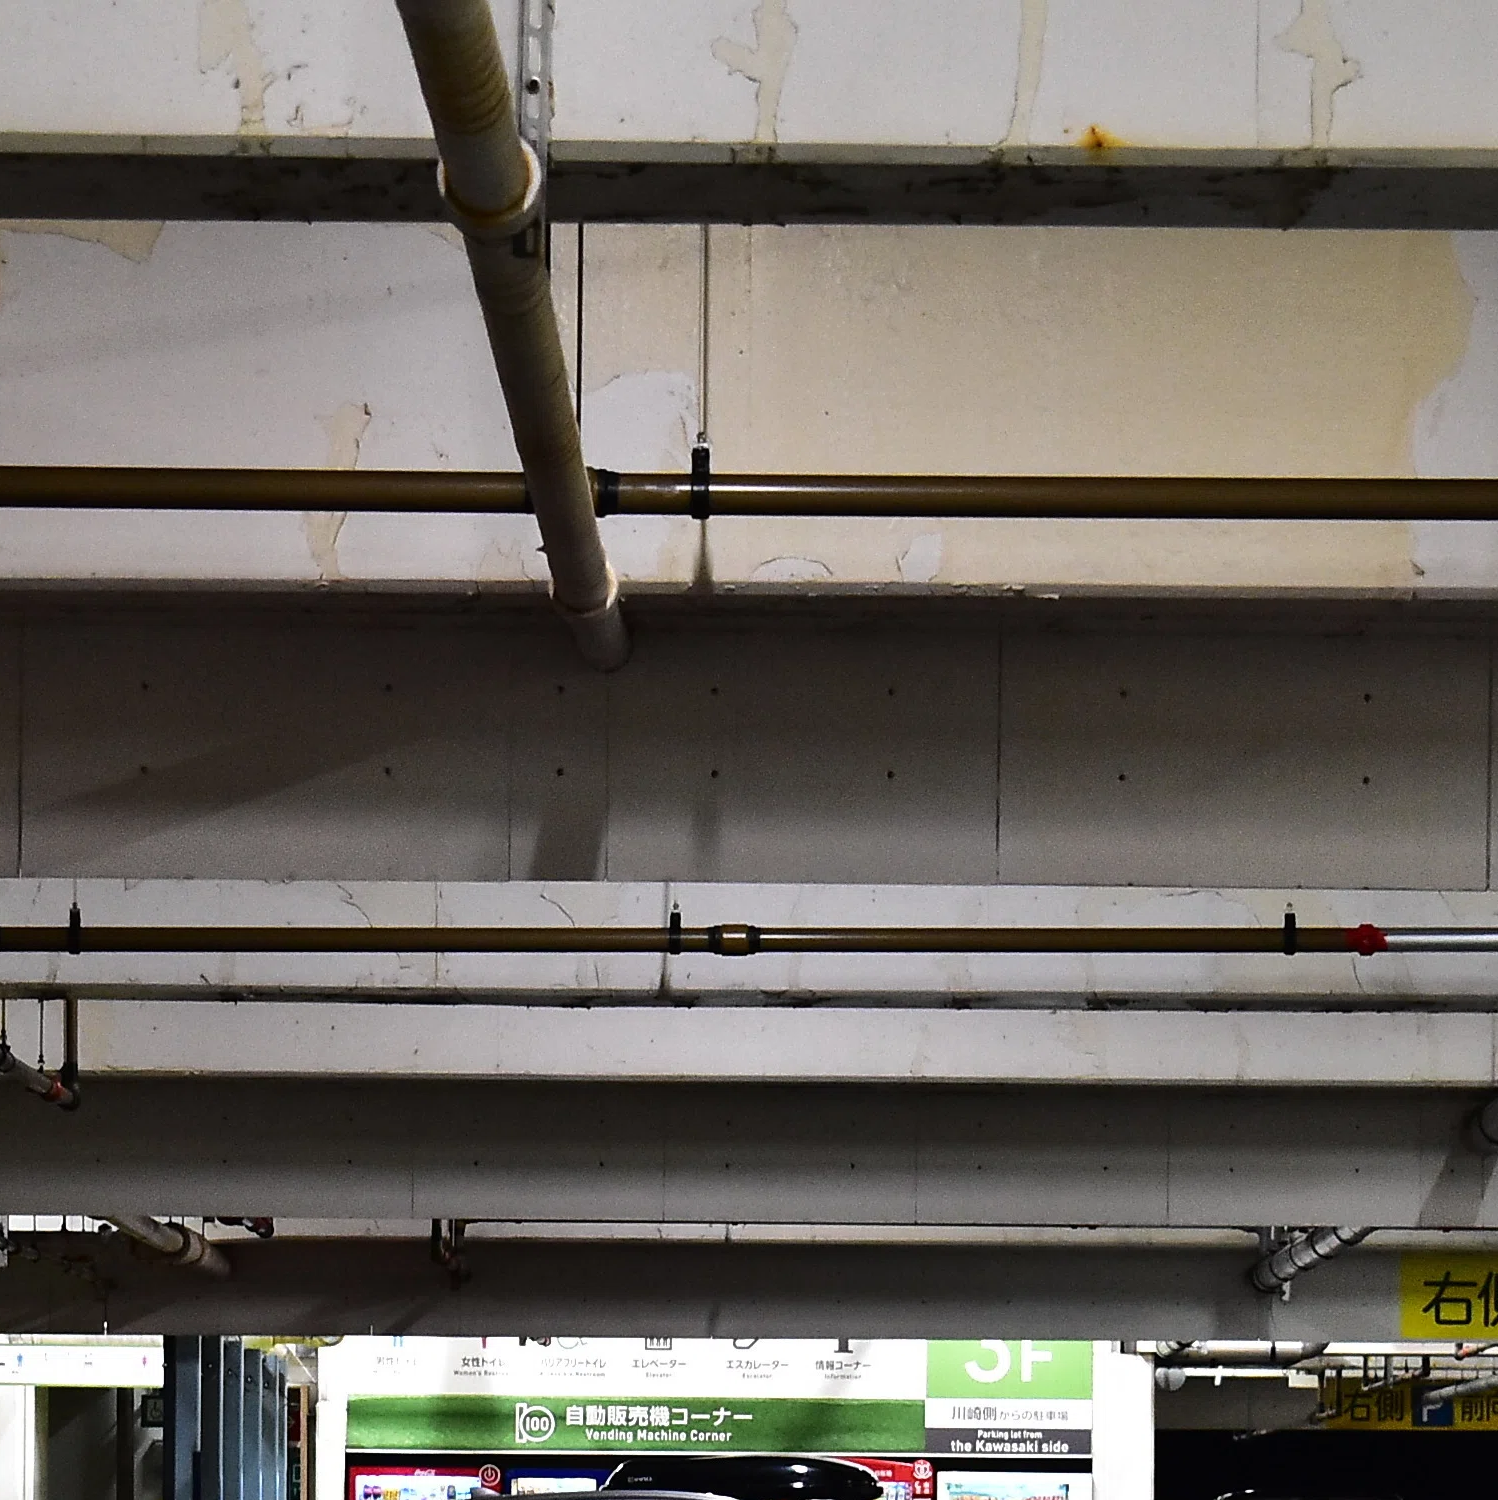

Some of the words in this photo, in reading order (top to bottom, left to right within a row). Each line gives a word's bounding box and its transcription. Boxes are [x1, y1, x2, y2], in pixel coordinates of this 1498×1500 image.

[630, 1359, 687, 1369] エレベーター
[725, 1359, 789, 1370] エスカレーター
[814, 1359, 872, 1371] 情報コーナー
[565, 1404, 754, 1427] 自動販売機コーナー
[585, 1428, 634, 1443] Vending
[637, 1428, 688, 1442] Machine
[690, 1429, 733, 1442] Corner
[977, 1429, 1009, 1440] Parking
[1010, 1430, 1022, 1439] lot
[1023, 1430, 1043, 1439] from
[950, 1440, 973, 1452] the
[975, 1440, 1039, 1452] Kawasaki
[1041, 1440, 1070, 1453] side
